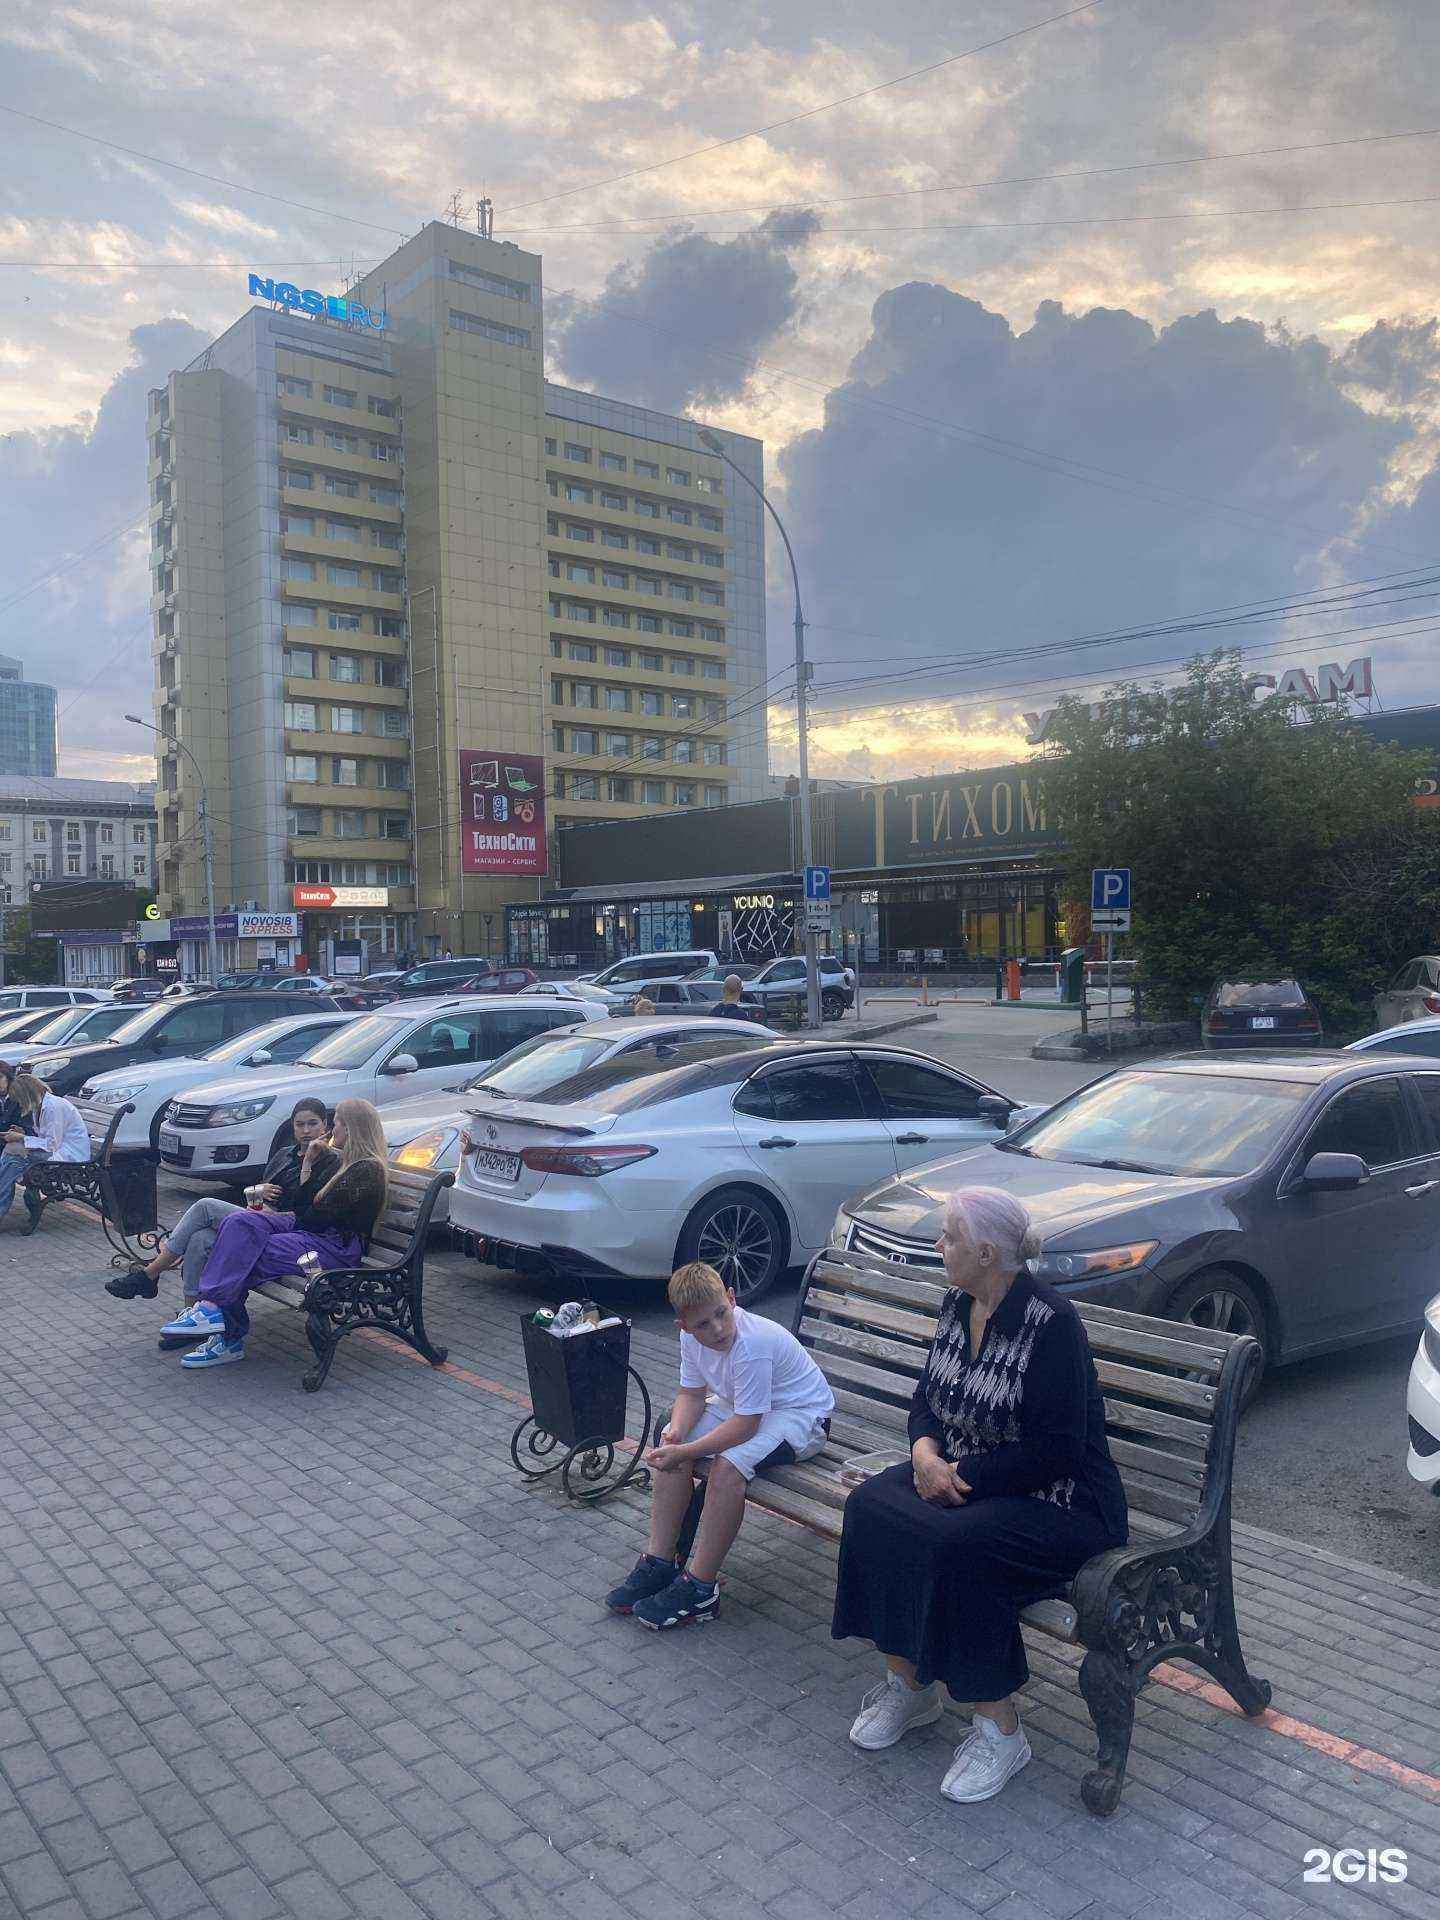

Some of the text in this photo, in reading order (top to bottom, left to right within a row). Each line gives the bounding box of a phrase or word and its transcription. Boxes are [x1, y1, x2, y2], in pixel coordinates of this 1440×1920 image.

[248, 273, 385, 330] NGS RU
[905, 779, 1060, 844] ТИХОМ
[472, 831, 536, 851] ТехноСити
[474, 857, 537, 866] МАГАЗИН СЕРВИС
[812, 871, 826, 896] P
[1103, 874, 1123, 905] P
[734, 894, 774, 909] YOUNIQ
[242, 916, 292, 926] NOVOSIB
[243, 925, 293, 935] EXPRESS
